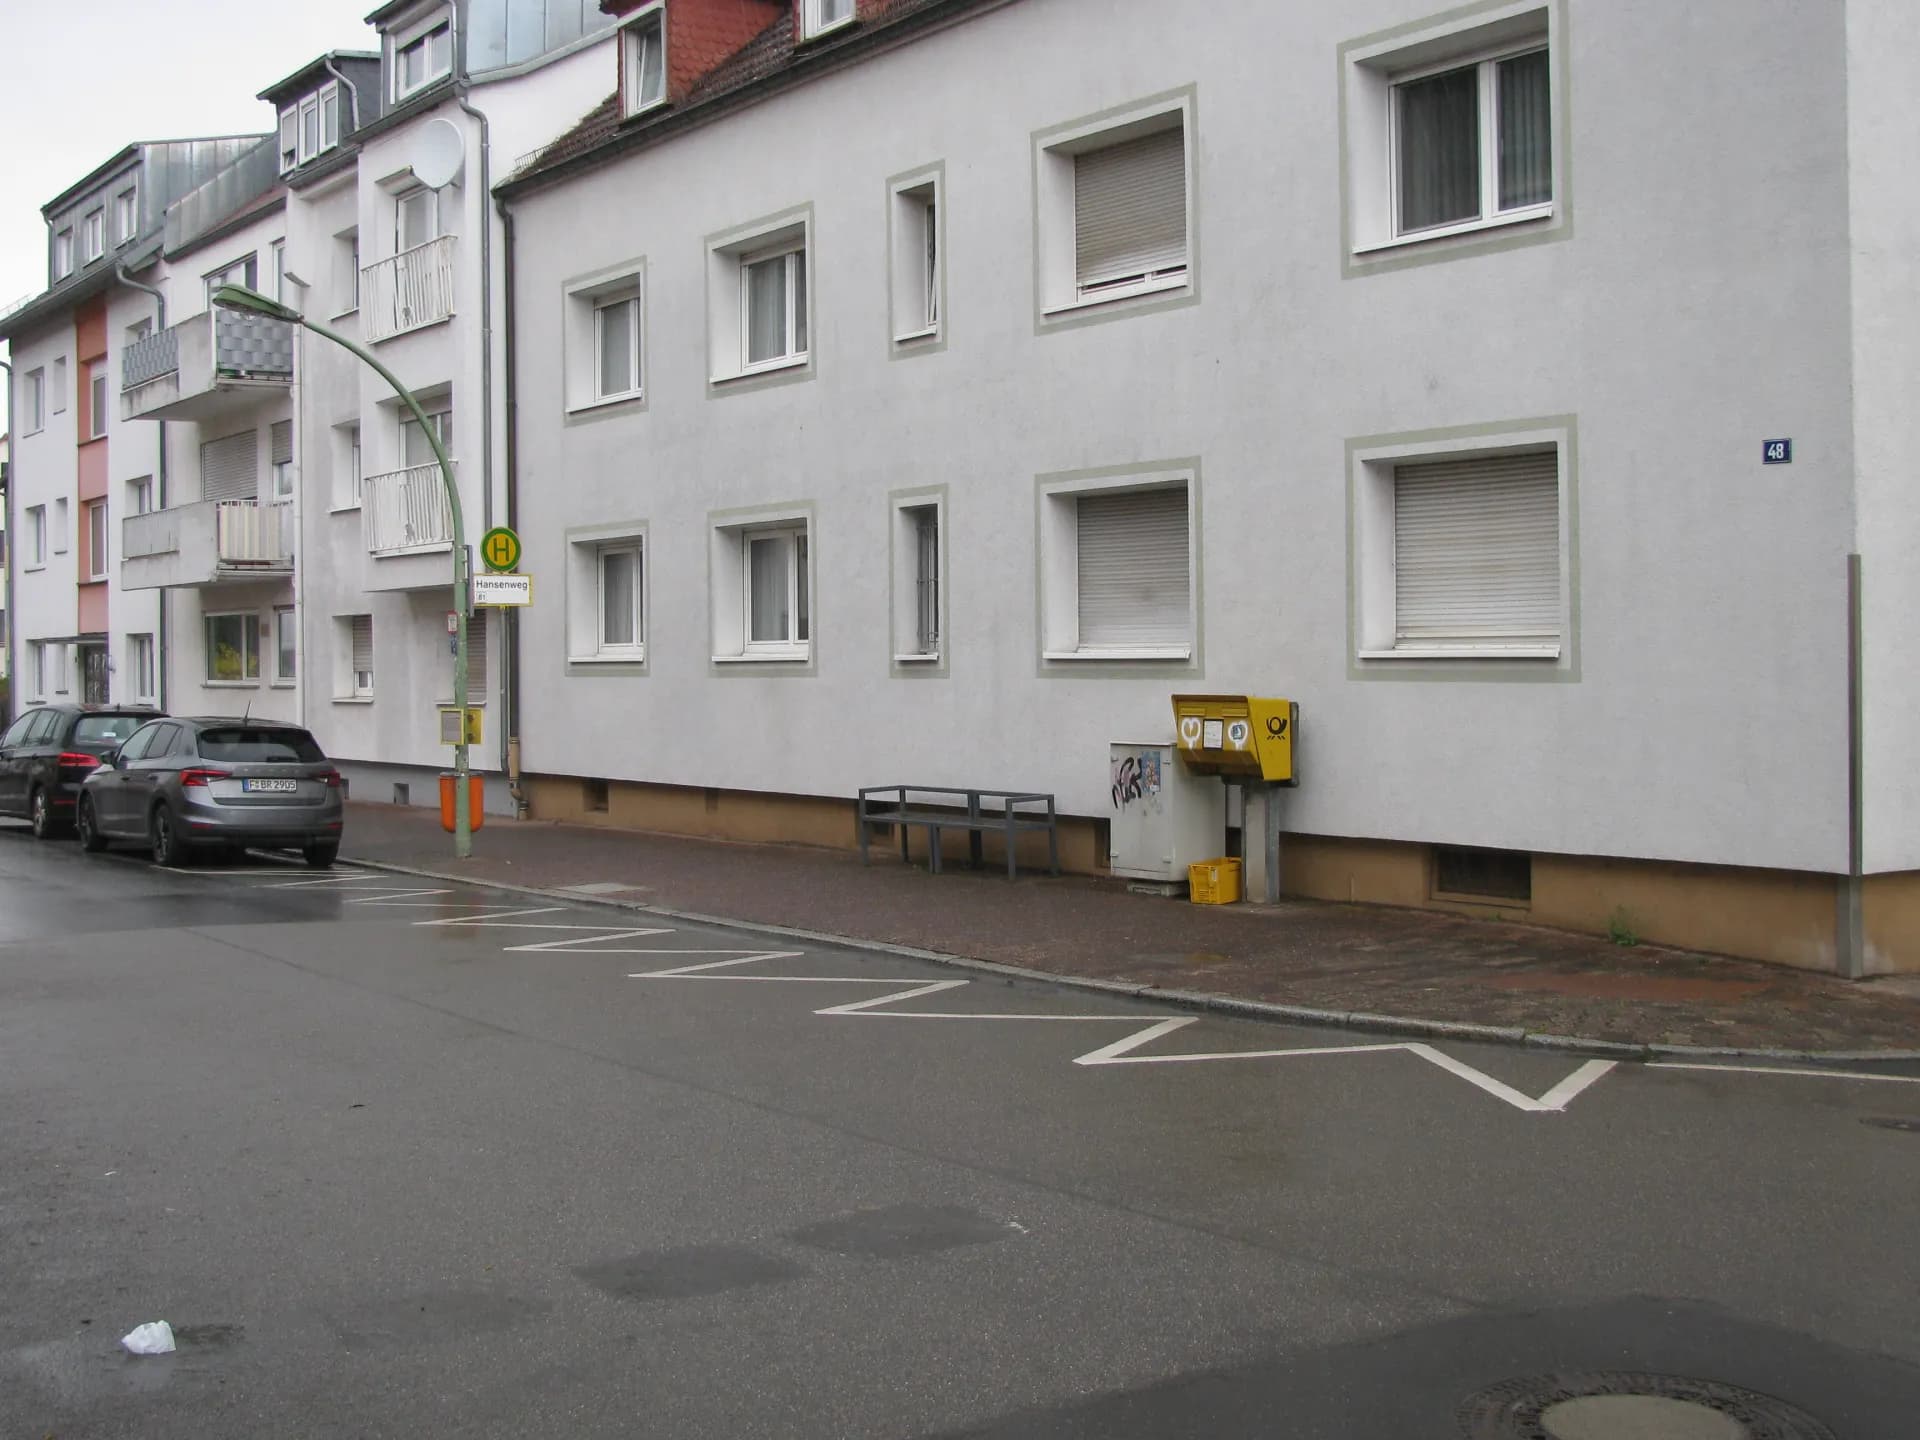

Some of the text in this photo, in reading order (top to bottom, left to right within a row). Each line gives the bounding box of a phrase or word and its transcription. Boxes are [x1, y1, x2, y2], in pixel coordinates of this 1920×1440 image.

[1768, 443, 1784, 459] 48
[493, 538, 509, 561] H
[476, 580, 528, 591] Hansenweg
